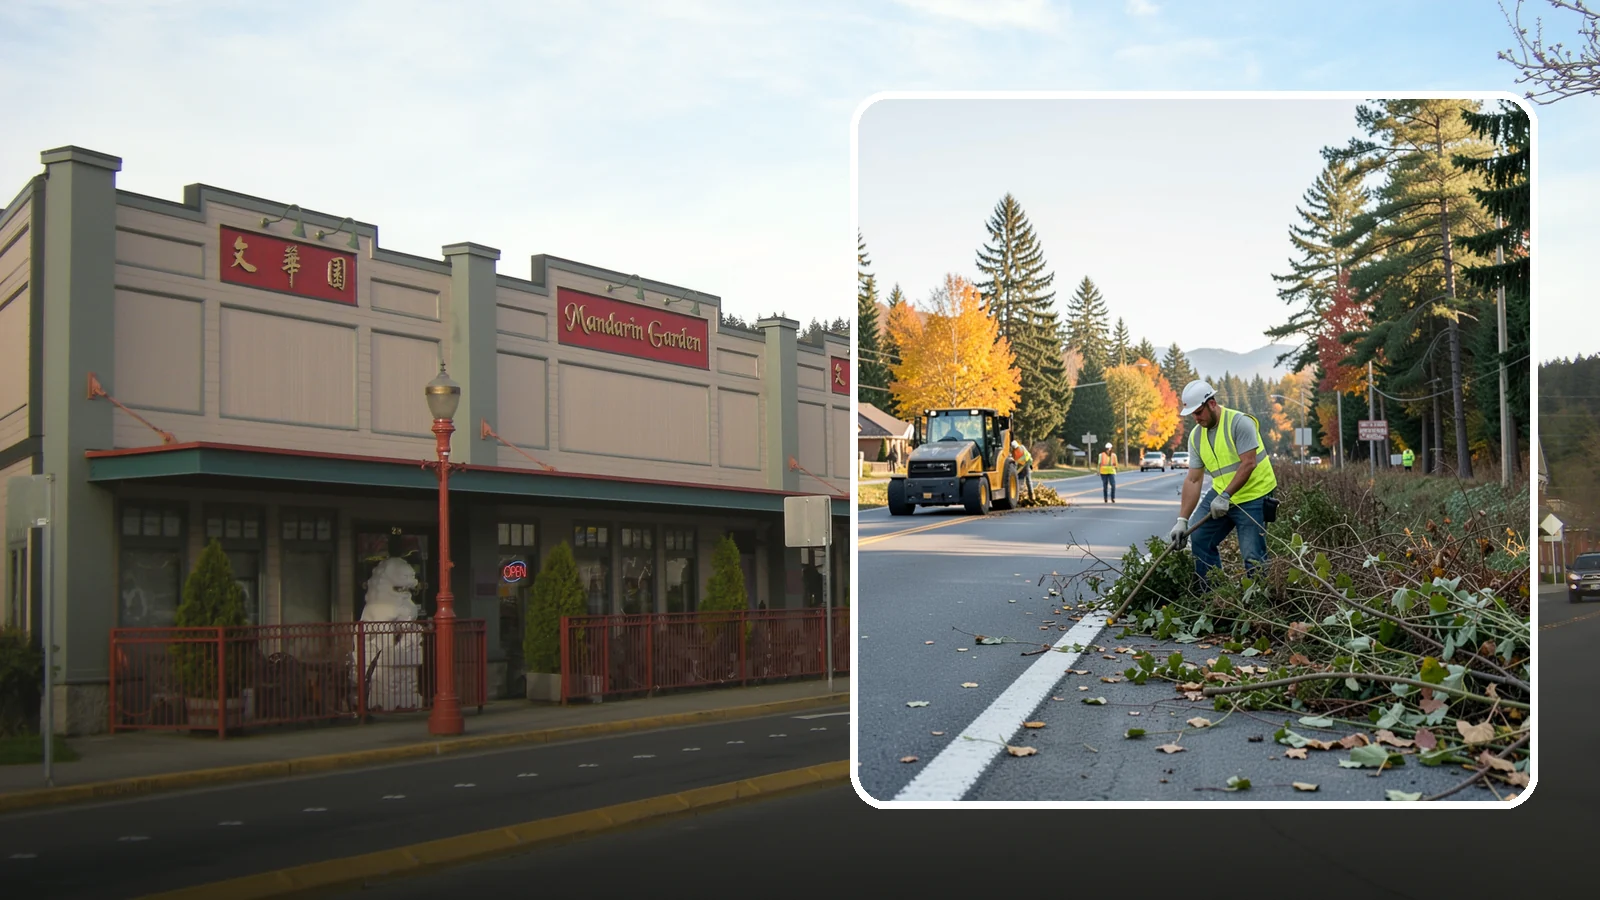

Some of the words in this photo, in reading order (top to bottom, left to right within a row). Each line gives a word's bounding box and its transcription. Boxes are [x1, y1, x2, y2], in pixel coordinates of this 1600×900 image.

[231, 236, 346, 290] 文華園
[565, 302, 644, 341] Mandarin
[648, 320, 701, 352] Garden
[503, 565, 527, 578] OPEN
